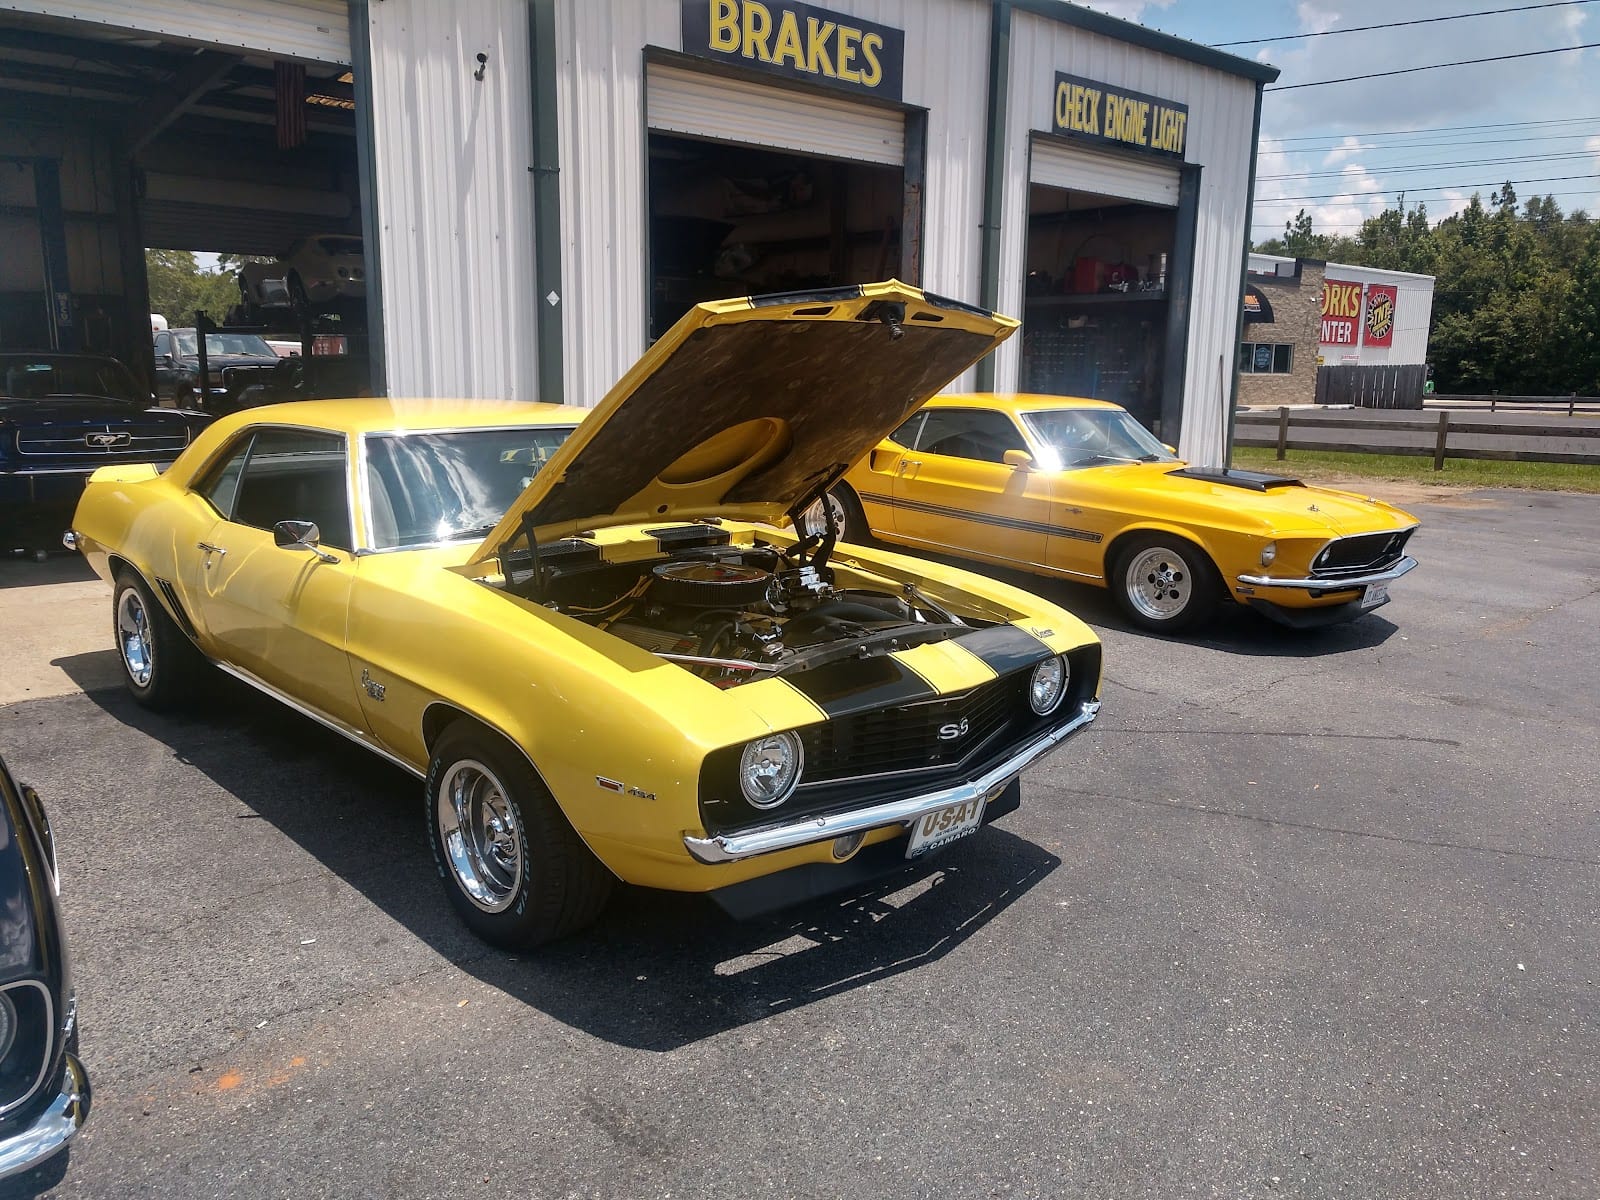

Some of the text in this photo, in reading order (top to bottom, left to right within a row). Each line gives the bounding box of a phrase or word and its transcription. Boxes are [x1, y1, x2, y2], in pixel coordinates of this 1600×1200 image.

[709, 0, 883, 88] BRAKES
[1056, 81, 1186, 154] CHECK ENGINE LIGHT
[1374, 300, 1391, 326] TNT
[939, 717, 969, 740] SS
[930, 827, 976, 850] CAMARO
